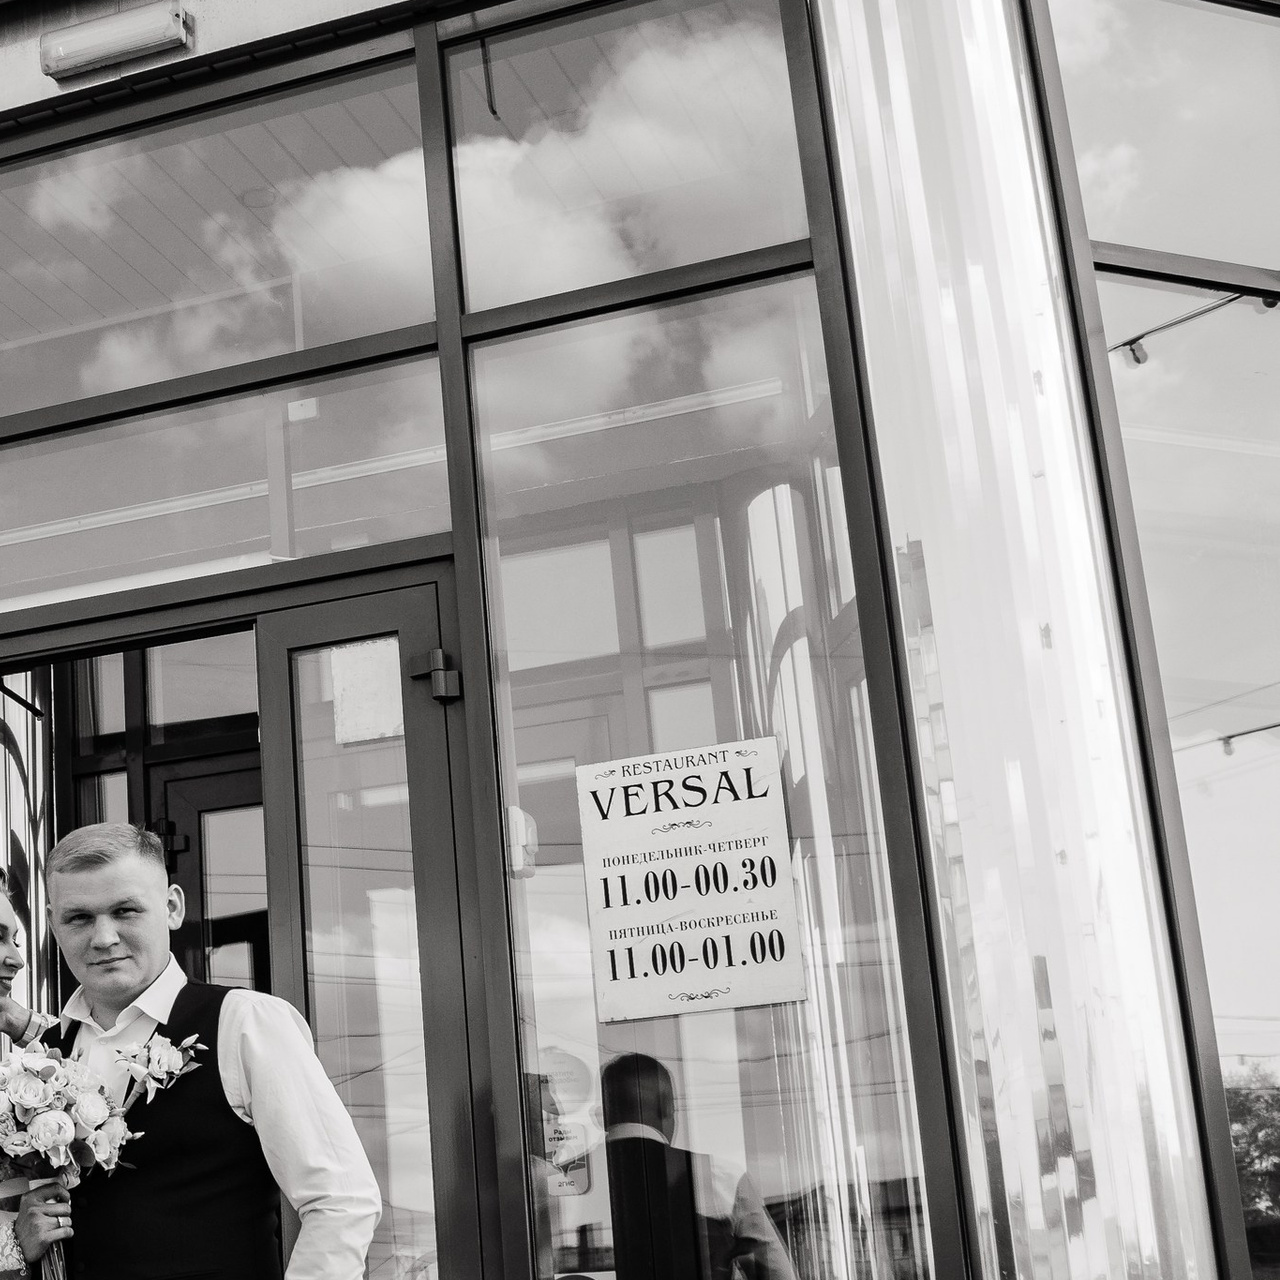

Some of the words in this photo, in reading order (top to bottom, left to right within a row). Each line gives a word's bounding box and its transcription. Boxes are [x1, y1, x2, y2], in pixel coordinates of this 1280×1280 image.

[621, 750, 730, 778] RESTAURANT
[589, 767, 770, 820] VERSAL
[602, 836, 769, 868] ПОНЕДЕЛЬНИК-ЧЕТВЕРГ
[600, 855, 777, 909] 11.00-00.30
[609, 909, 779, 941] ПЯТНИЦА-ВОСКРЕСЕНЬЕ
[606, 929, 786, 982] 11.00-01.00
